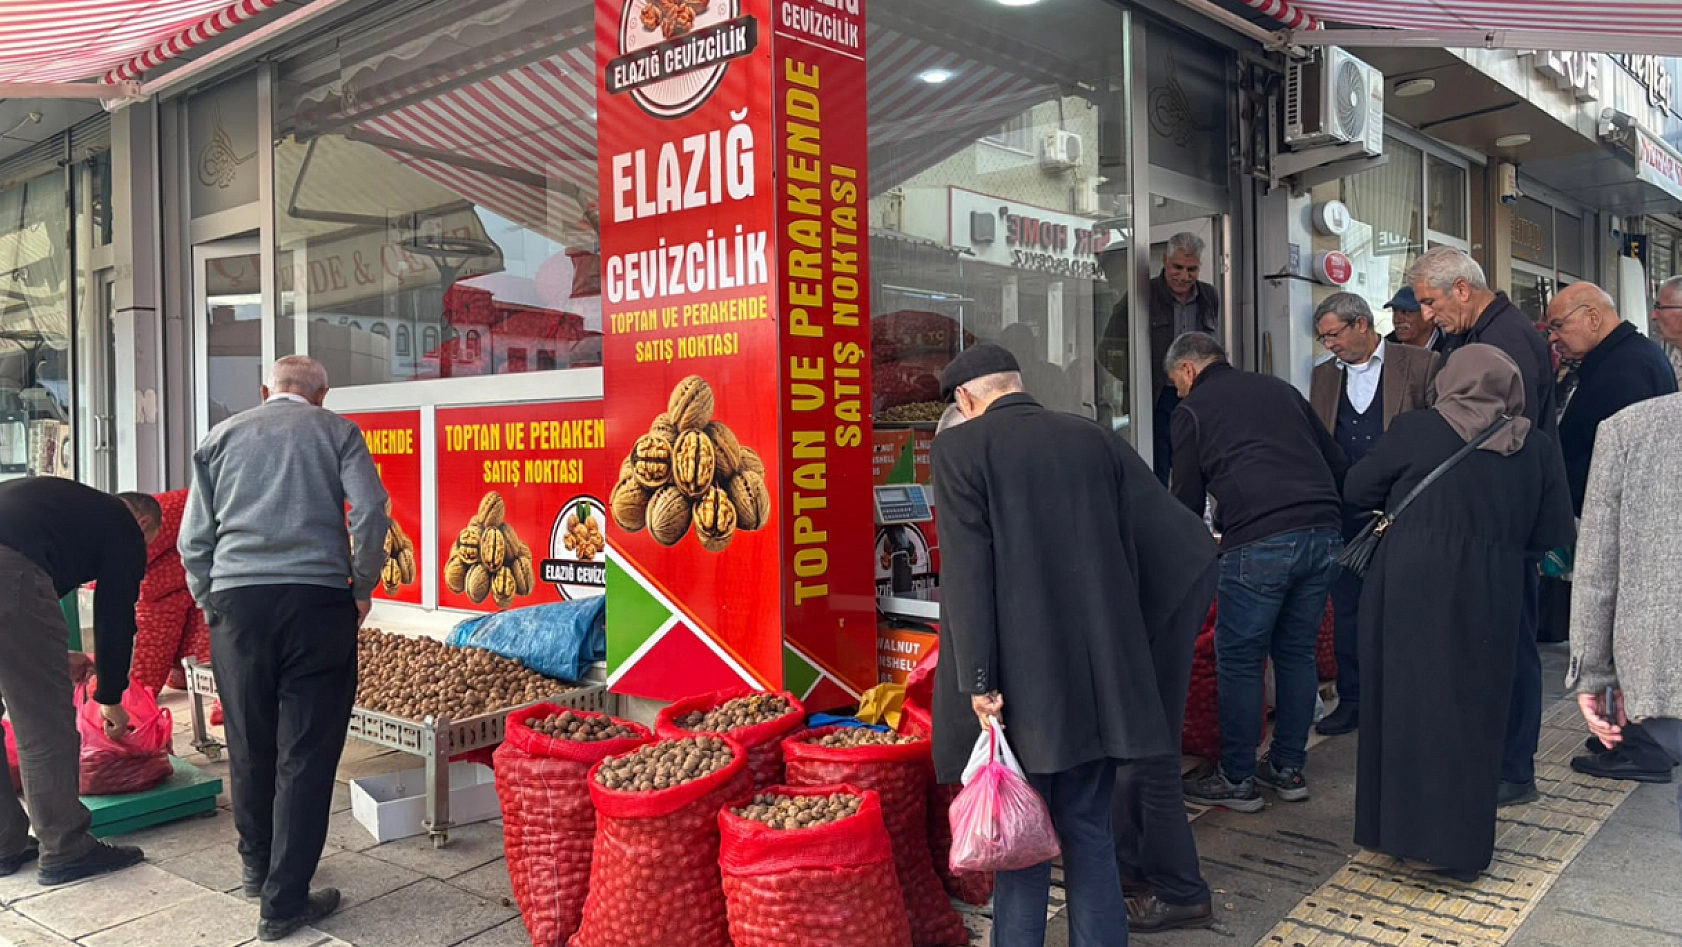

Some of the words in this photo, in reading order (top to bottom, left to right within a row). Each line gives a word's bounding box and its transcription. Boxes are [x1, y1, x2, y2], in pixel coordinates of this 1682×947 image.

[782, 2, 858, 49] CEVİZCİLİK
[614, 50, 660, 88] ELAZIĞ
[665, 25, 747, 73] CEVİZCİLİK
[612, 107, 755, 223] ELAZIĞ
[785, 57, 824, 337] PERAKENDE
[607, 224, 768, 303] CEVİZCİLİK
[830, 164, 859, 327] NOKTASI
[611, 309, 658, 334] TOPTAN
[662, 306, 679, 329] VE
[683, 295, 768, 327] PERAKENDE
[636, 337, 673, 363] SATIŞ
[678, 332, 738, 359] NOKTASI
[790, 355, 826, 411] VE
[833, 341, 865, 447] SATIŞ
[361, 428, 414, 455] AKENDE
[445, 424, 500, 452] TOPTAN
[505, 422, 525, 450] VE
[530, 419, 605, 450] PERAKEN
[483, 460, 520, 487] SATIŞ
[524, 459, 583, 484] NOKTASI
[792, 430, 829, 606] TOPTAN
[546, 563, 574, 582] ELAZIĞ
[577, 565, 605, 584] CEVİZC
